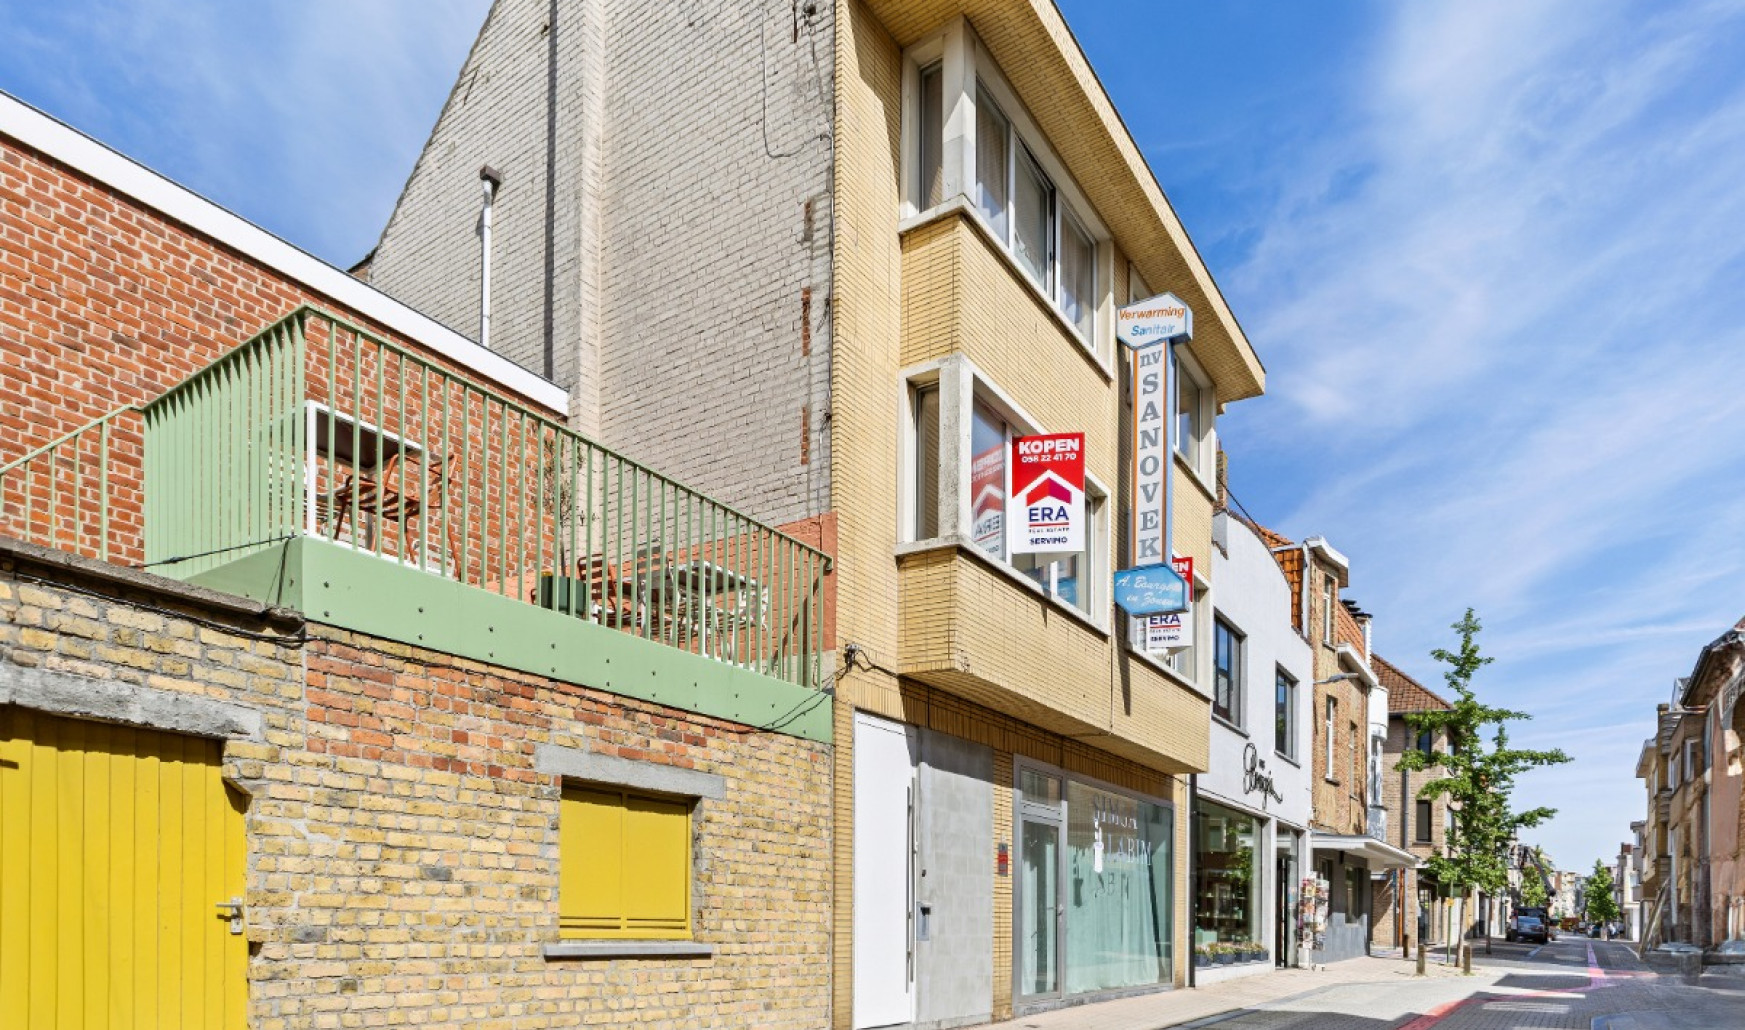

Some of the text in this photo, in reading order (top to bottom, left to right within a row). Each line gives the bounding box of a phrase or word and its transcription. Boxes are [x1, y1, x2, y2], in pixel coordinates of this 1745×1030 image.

[1120, 306, 1185, 320] Verwarming
[1131, 323, 1176, 336] Sanitair
[1139, 350, 1163, 368] nv
[1018, 438, 1080, 454] KOPEN
[1041, 454, 1051, 462] 22
[1053, 453, 1063, 461] 41
[1064, 452, 1077, 460] 70
[1139, 373, 1161, 558] SANOVEK
[1028, 506, 1070, 522] ERA
[1149, 614, 1181, 625] ERA
